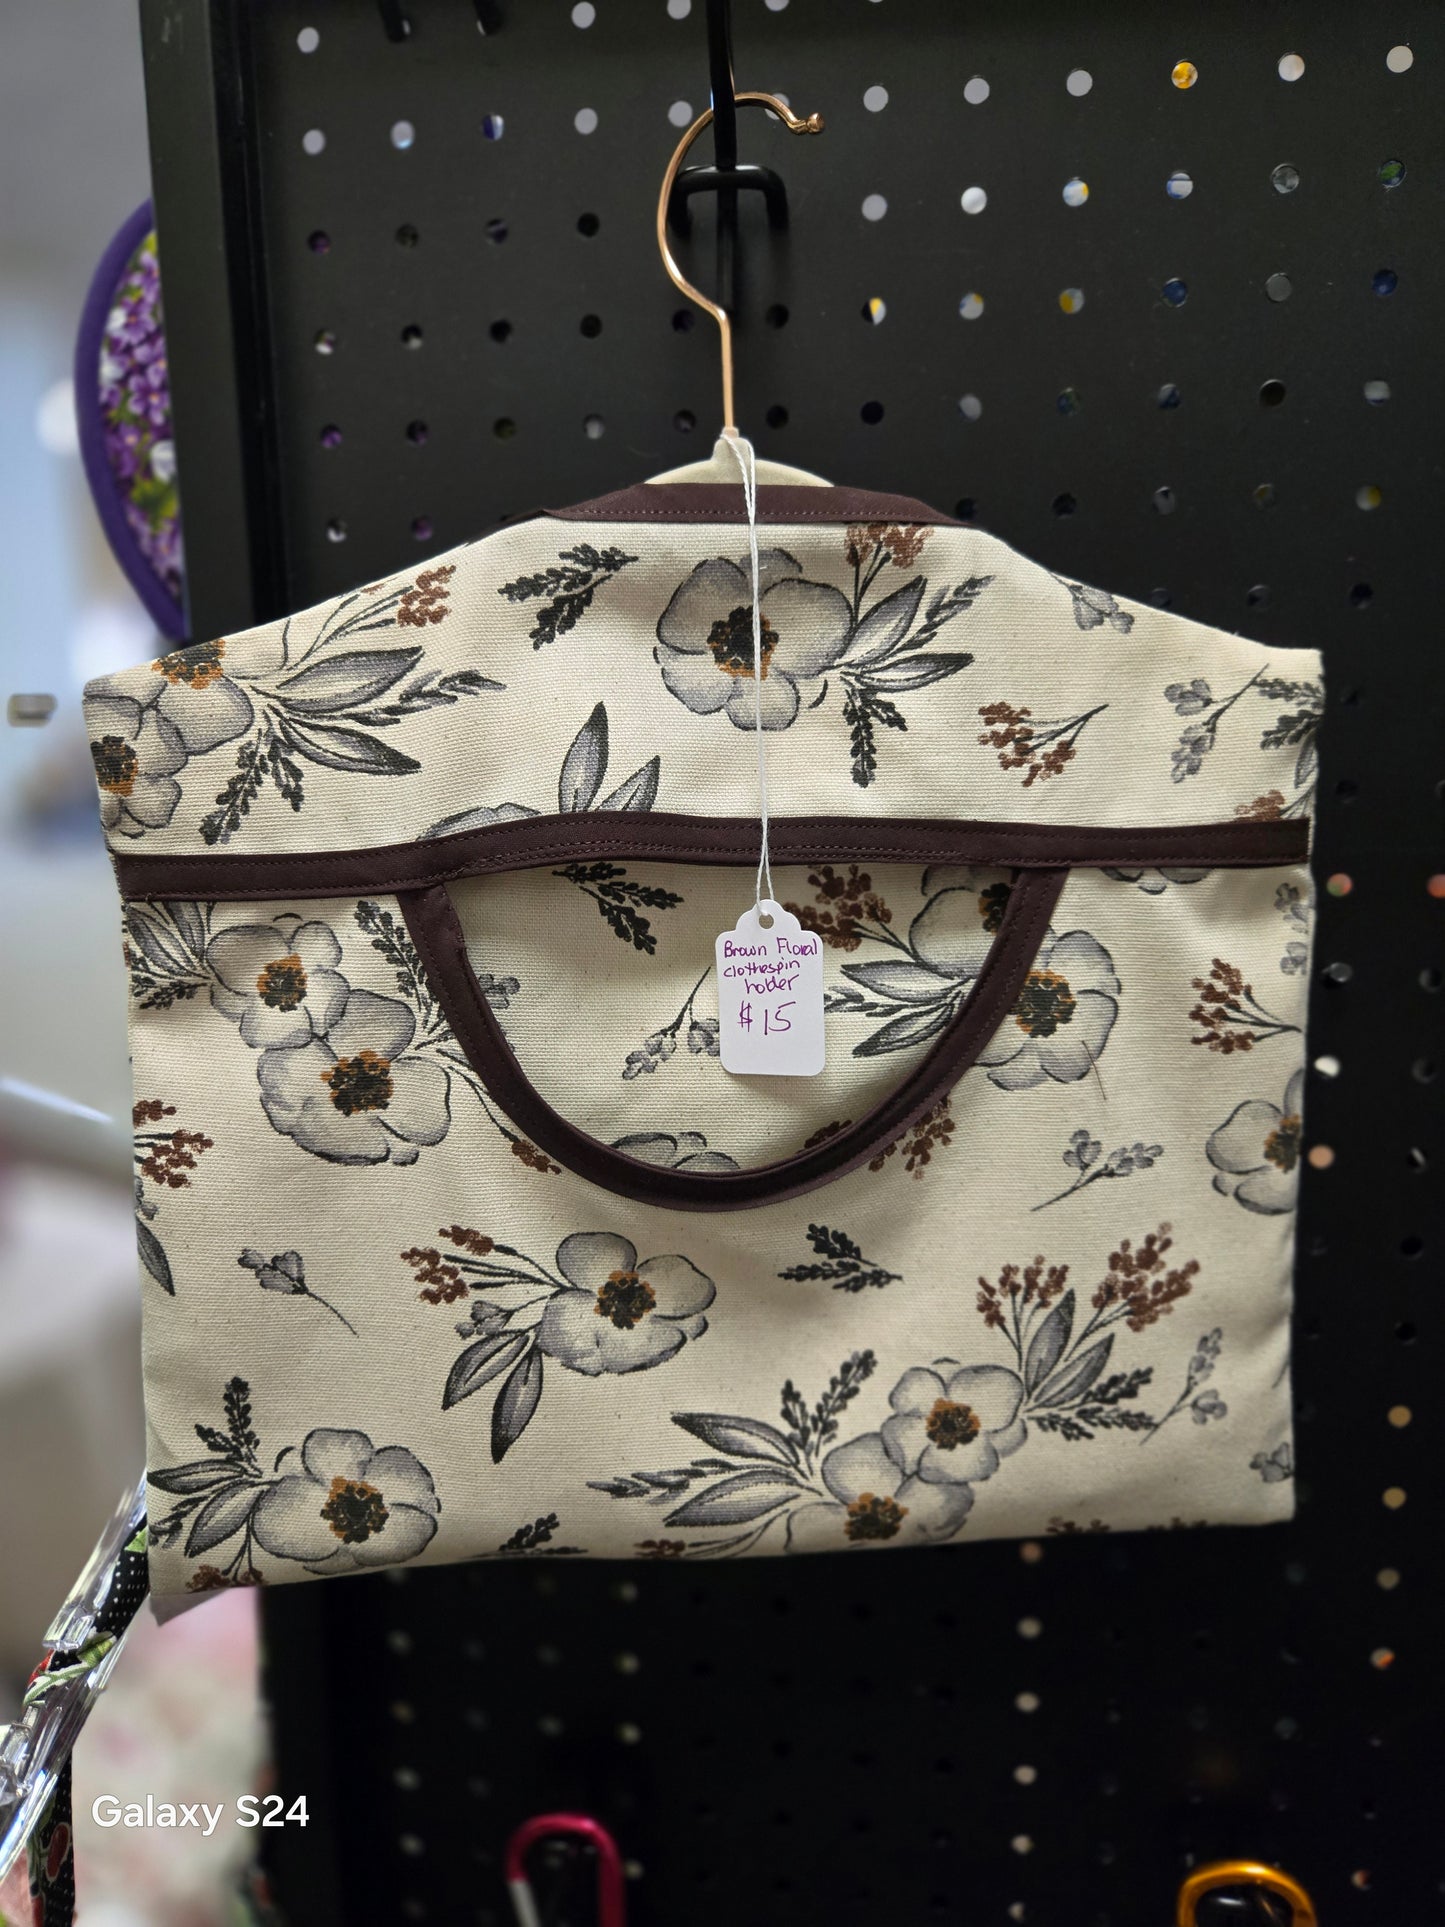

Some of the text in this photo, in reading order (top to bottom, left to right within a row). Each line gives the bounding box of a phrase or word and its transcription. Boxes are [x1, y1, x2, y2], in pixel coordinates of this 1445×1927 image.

[724, 937, 818, 959] Brown Floral
[723, 957, 801, 978] clothespin
[744, 974, 800, 994] holder
